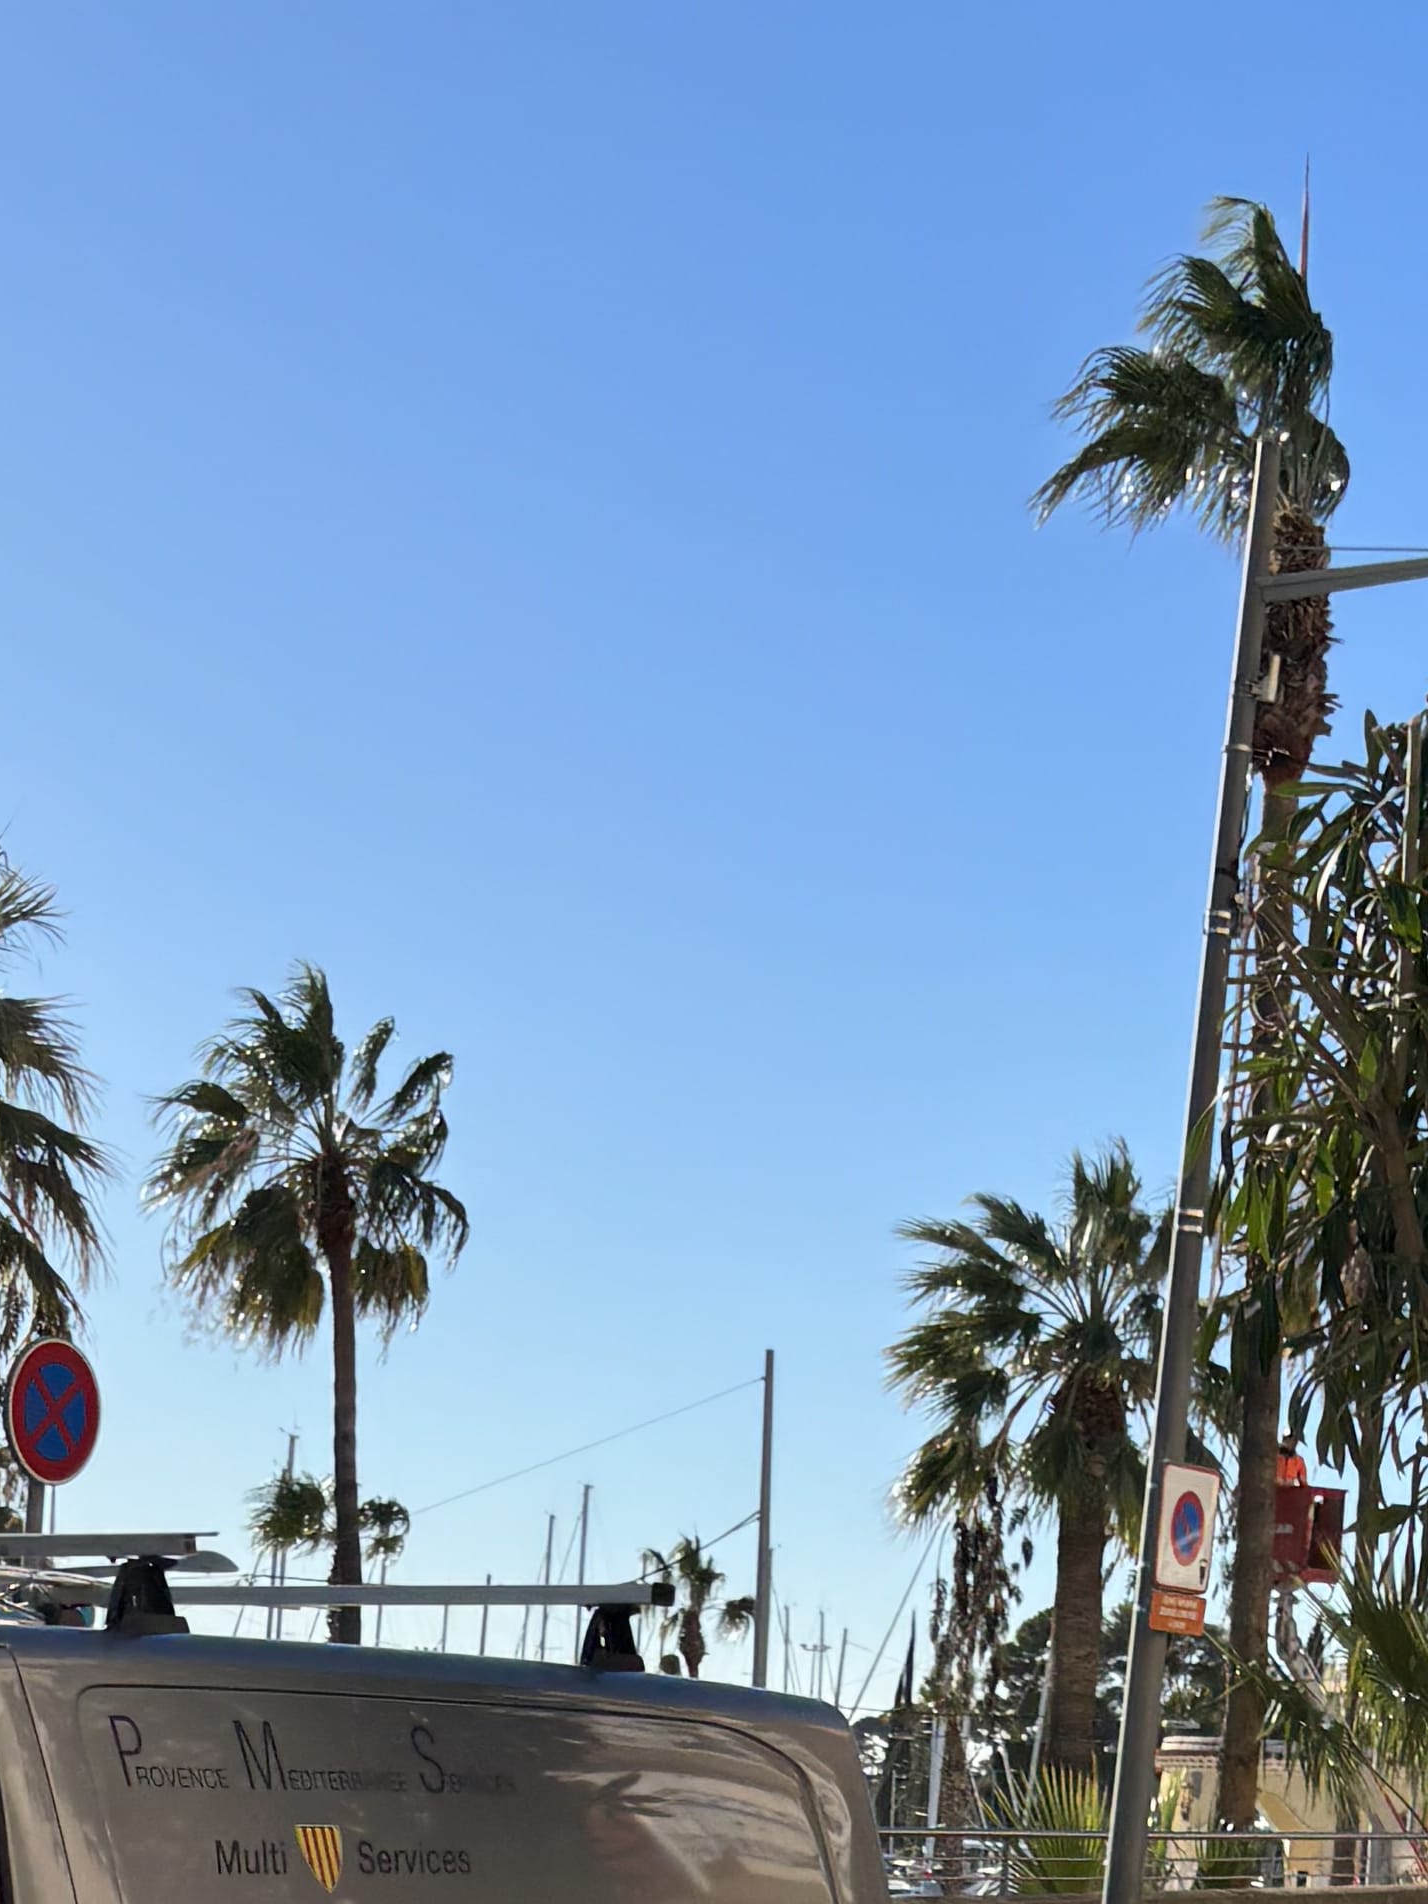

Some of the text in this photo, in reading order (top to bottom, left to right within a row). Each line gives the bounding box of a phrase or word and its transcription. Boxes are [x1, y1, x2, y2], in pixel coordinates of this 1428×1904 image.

[108, 1715, 229, 1788] PROVENCE
[232, 1720, 406, 1791] MEDITERREE
[215, 1839, 471, 1875] Multi Services
